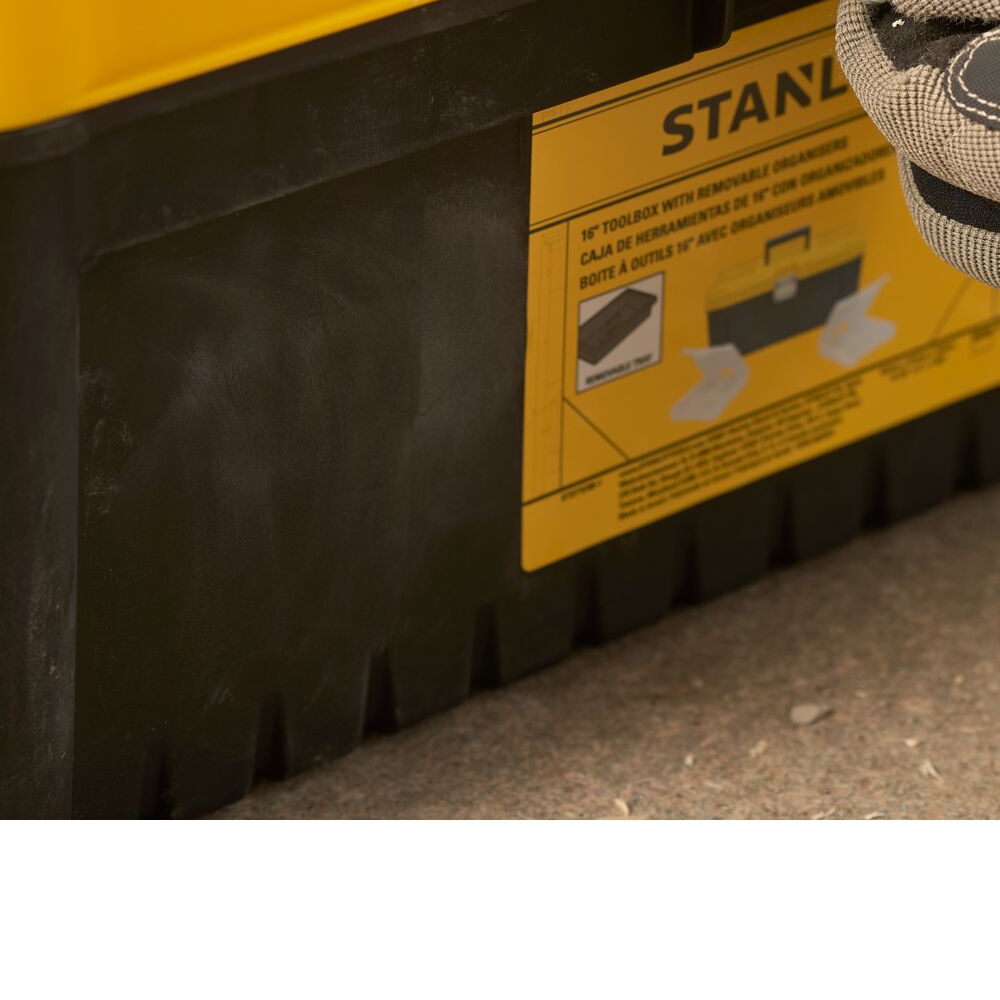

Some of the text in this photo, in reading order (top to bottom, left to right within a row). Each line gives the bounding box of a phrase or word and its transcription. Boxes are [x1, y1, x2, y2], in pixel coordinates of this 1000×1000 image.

[661, 55, 848, 156] STANL
[579, 265, 616, 290] BOITE
[630, 244, 674, 271] OUTILS
[697, 225, 728, 247] AVEC
[730, 193, 815, 235] ORGANISEURS
[817, 167, 886, 201] AMOVIBLES
[580, 244, 614, 266] CAJA
[616, 236, 633, 252] DE
[635, 201, 731, 246] HERRAMIENTAS
[733, 195, 749, 210] DE
[771, 178, 797, 197] CON
[602, 203, 659, 234] TOOLBOX
[661, 190, 695, 214] WITH
[697, 164, 769, 200] REMOVABLE
[772, 136, 848, 174] ORGANISERS
